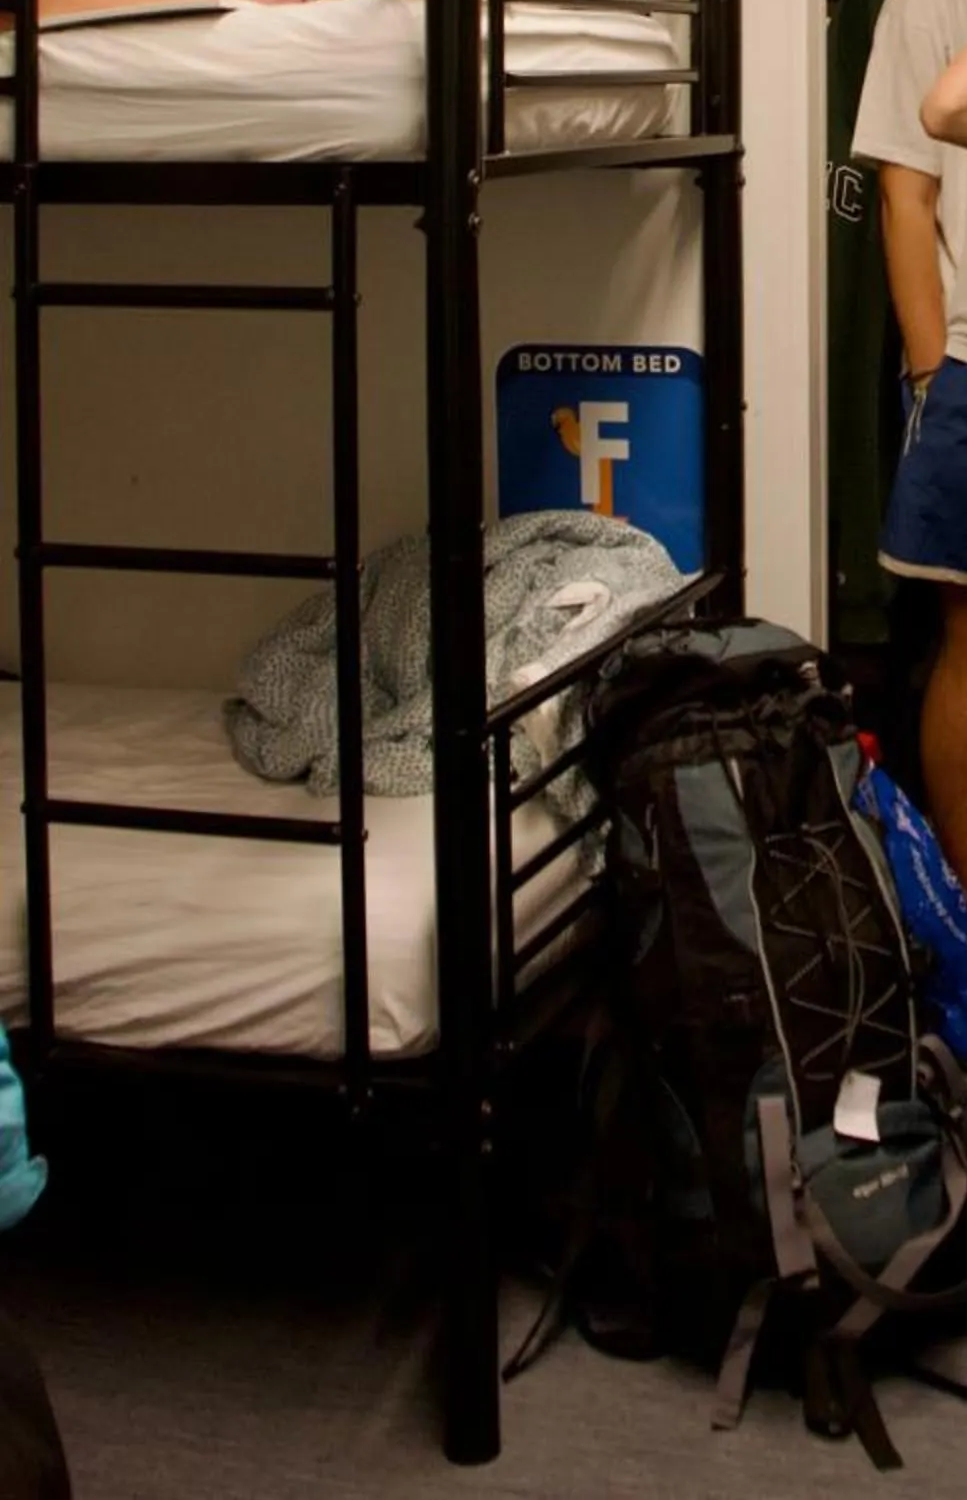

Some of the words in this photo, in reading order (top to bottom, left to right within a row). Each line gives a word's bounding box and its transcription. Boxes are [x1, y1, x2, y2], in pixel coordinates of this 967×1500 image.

[518, 352, 622, 372] BOTTOM
[632, 354, 682, 373] BED
[579, 401, 630, 504] F
